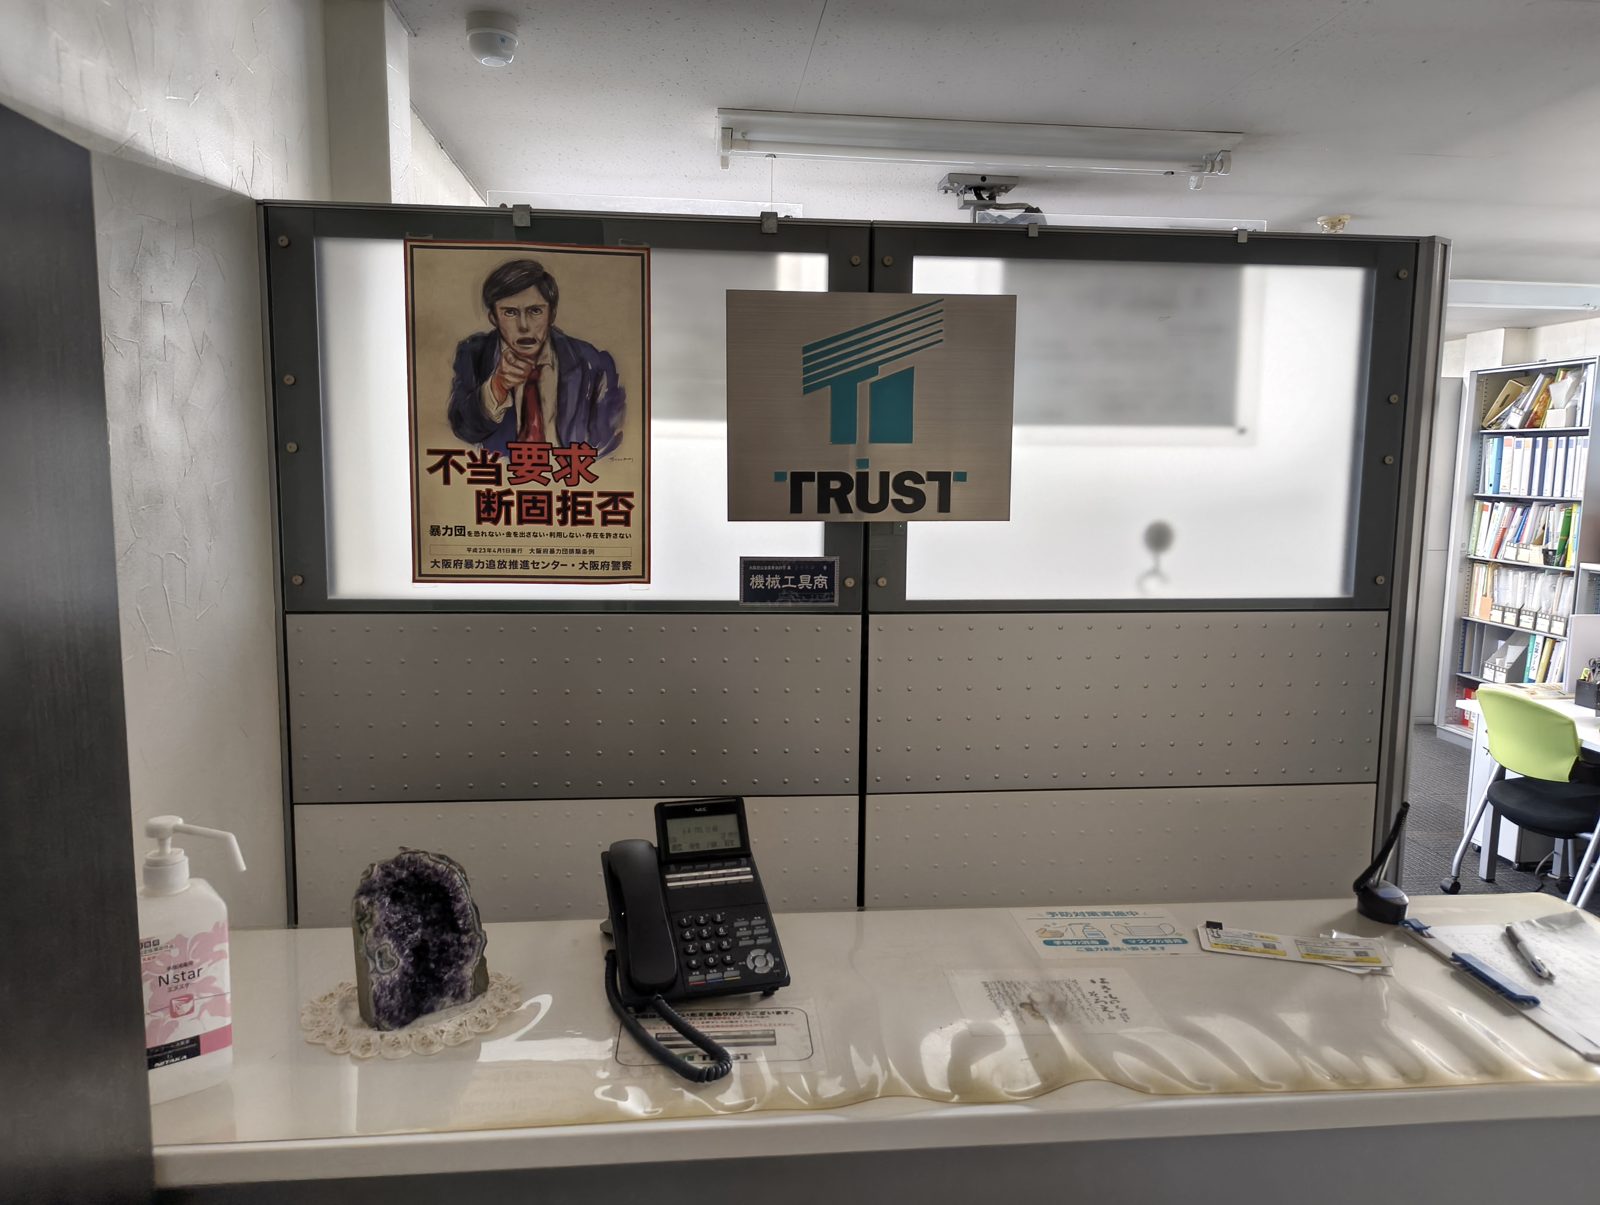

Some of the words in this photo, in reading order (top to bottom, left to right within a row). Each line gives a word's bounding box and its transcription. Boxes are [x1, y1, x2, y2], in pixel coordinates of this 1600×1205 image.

[426, 441, 599, 487] 不当要求
[474, 488, 635, 527] 断固拒否
[774, 464, 967, 514] TRUST
[749, 574, 829, 590] 機械工具商
